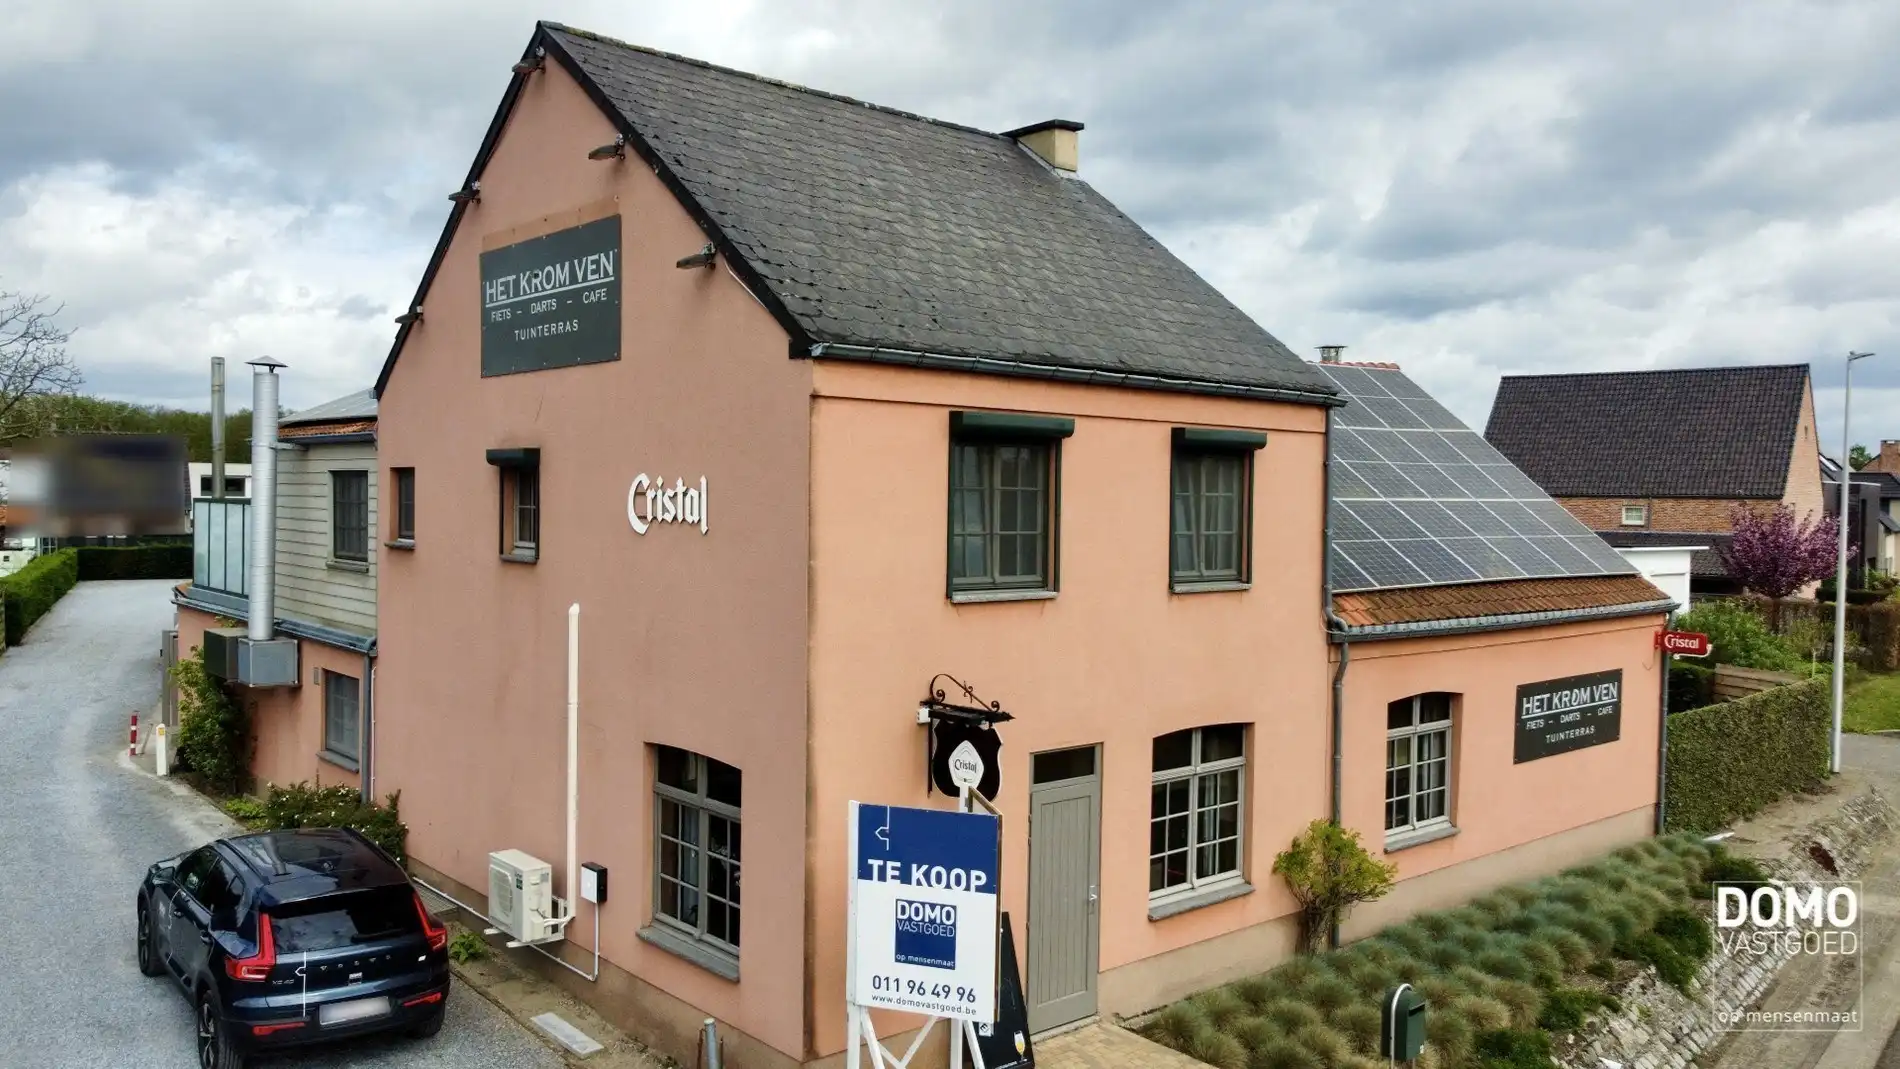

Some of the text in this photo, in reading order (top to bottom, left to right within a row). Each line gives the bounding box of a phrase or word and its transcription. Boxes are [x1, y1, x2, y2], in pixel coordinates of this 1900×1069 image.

[486, 251, 614, 303] HET KROM VEN
[491, 308, 511, 322] FIETS
[531, 299, 557, 314] DARTS
[583, 288, 607, 304] CAFE
[515, 319, 579, 341] TUINTERRAS
[627, 472, 709, 536] Cristal
[1664, 634, 1699, 649] Cristal
[1522, 682, 1618, 715] HET KROM VEN
[1526, 719, 1544, 730] FIETS
[1560, 712, 1580, 723] DARTS
[1597, 705, 1613, 716] CAFE
[1545, 725, 1595, 743] TUINTERRAS
[954, 759, 977, 773] Cristal
[868, 859, 987, 894] TE KOOP
[896, 901, 955, 925] DOMO
[896, 920, 955, 937] VASTGOED
[908, 956, 955, 967] mensenmaat
[872, 975, 976, 1003] 011 96 49 96
[872, 995, 977, 1016] www.domovastgoed.be
